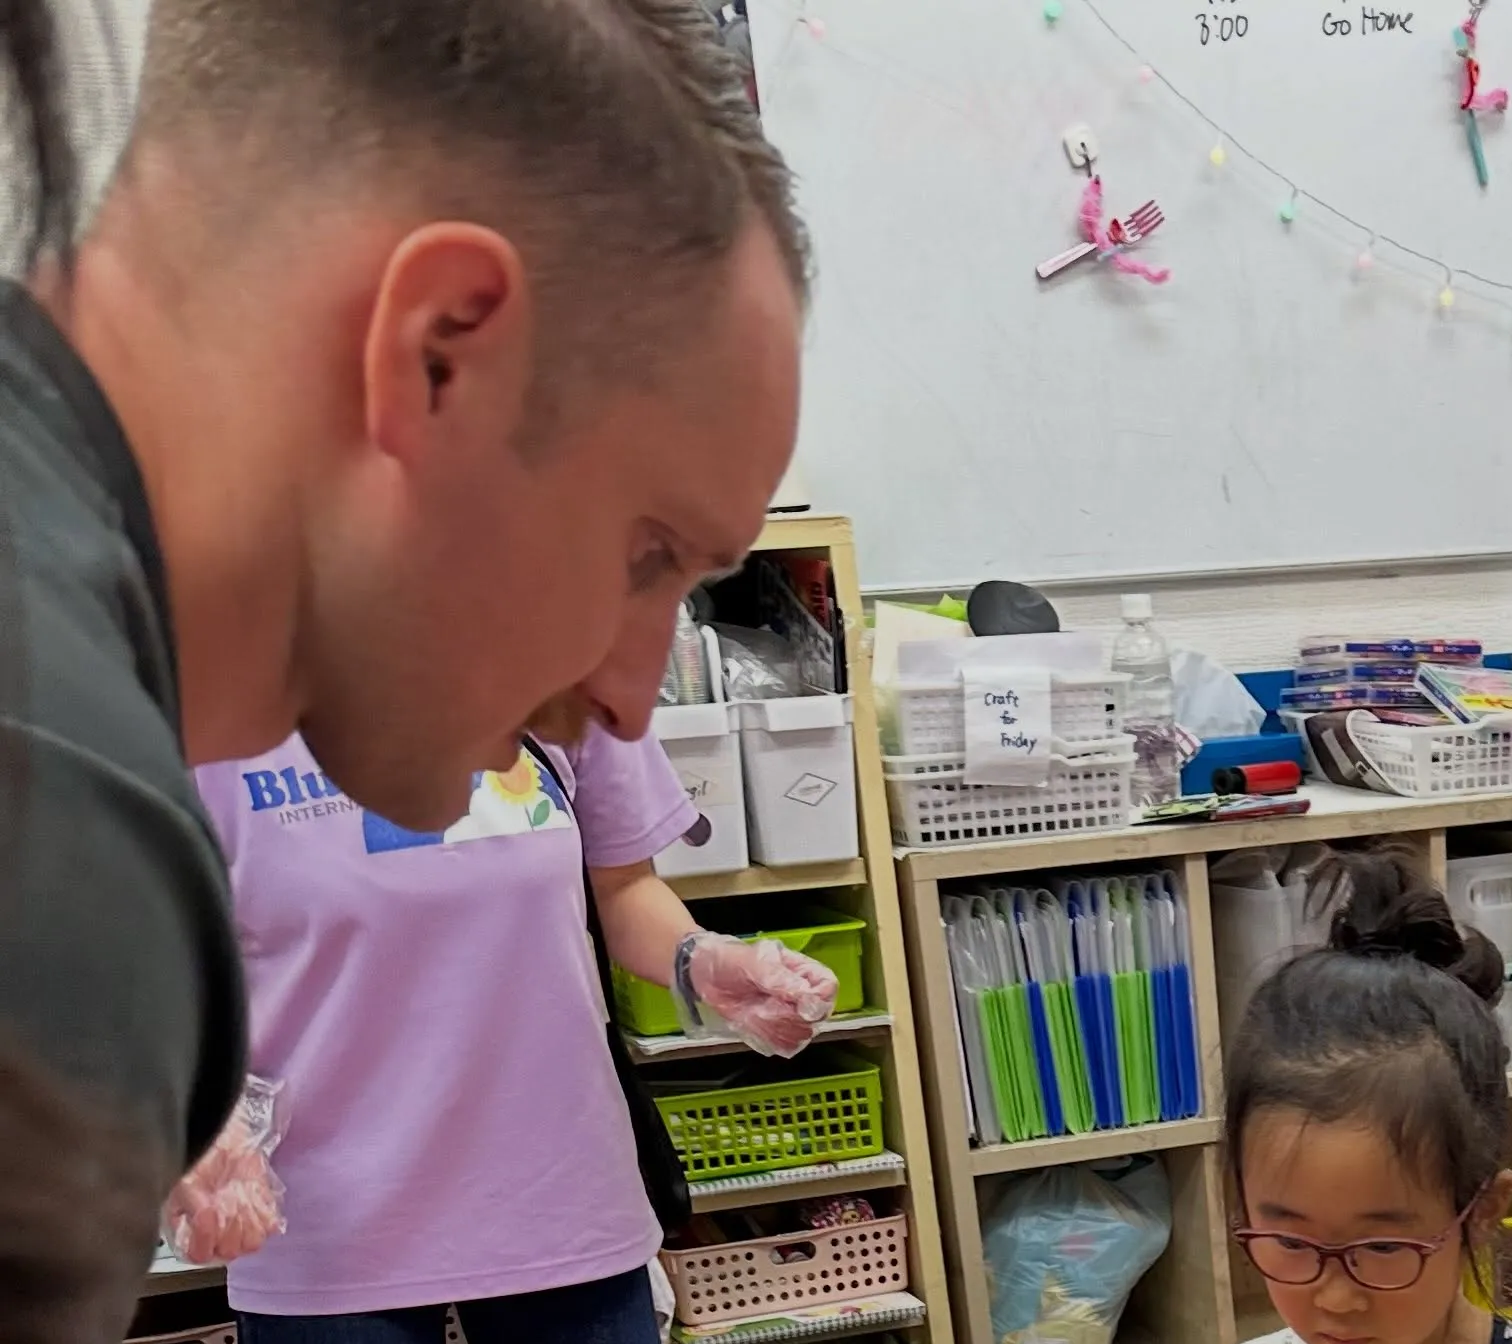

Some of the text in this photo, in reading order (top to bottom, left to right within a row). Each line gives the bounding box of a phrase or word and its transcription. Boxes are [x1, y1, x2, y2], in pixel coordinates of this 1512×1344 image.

[1321, 11, 1352, 36] Go
[1361, 5, 1414, 36] Home
[984, 689, 1020, 709] Craft
[999, 709, 1019, 725] for
[1000, 731, 1039, 755] Friday
[242, 766, 343, 812] Blu
[279, 800, 365, 825] INTERN
